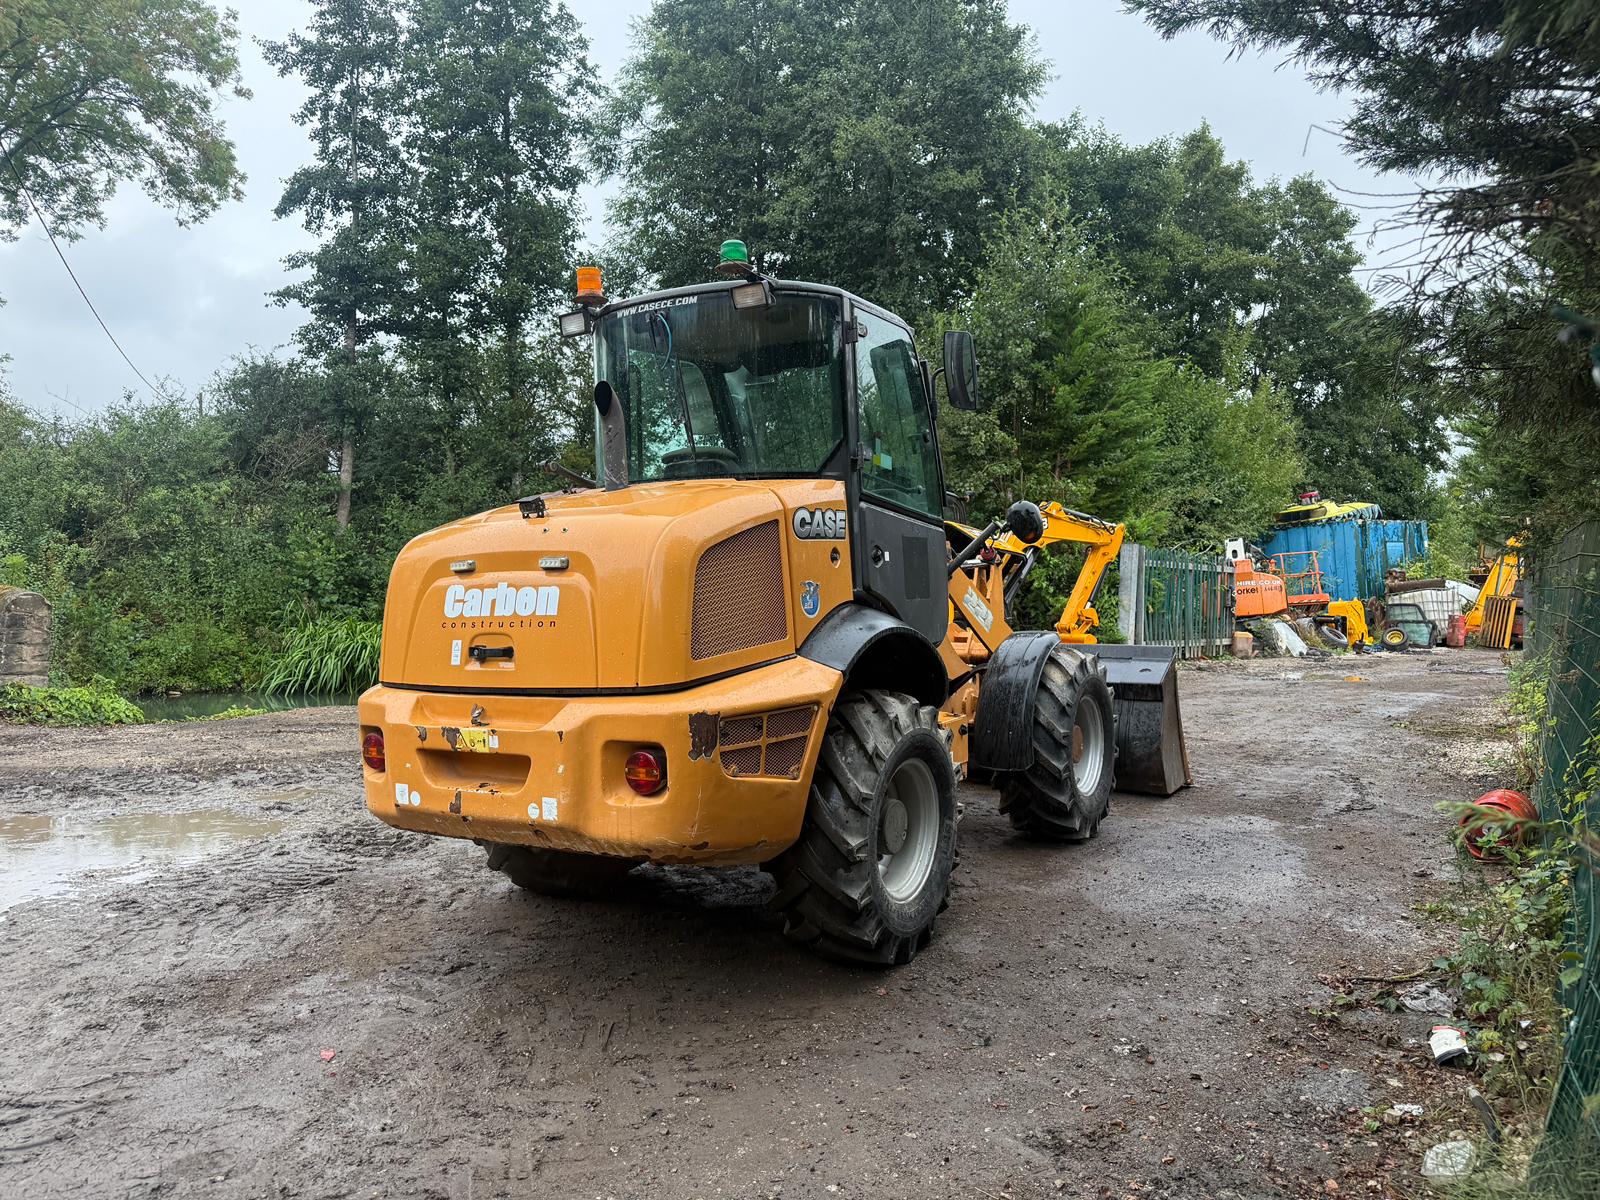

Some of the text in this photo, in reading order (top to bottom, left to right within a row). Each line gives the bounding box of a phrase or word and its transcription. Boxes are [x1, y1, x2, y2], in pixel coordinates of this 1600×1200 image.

[616, 296, 698, 319] WWW.CASECE.COM
[793, 508, 846, 538] CASE
[443, 582, 560, 618] Carbon
[441, 619, 556, 629] construction
